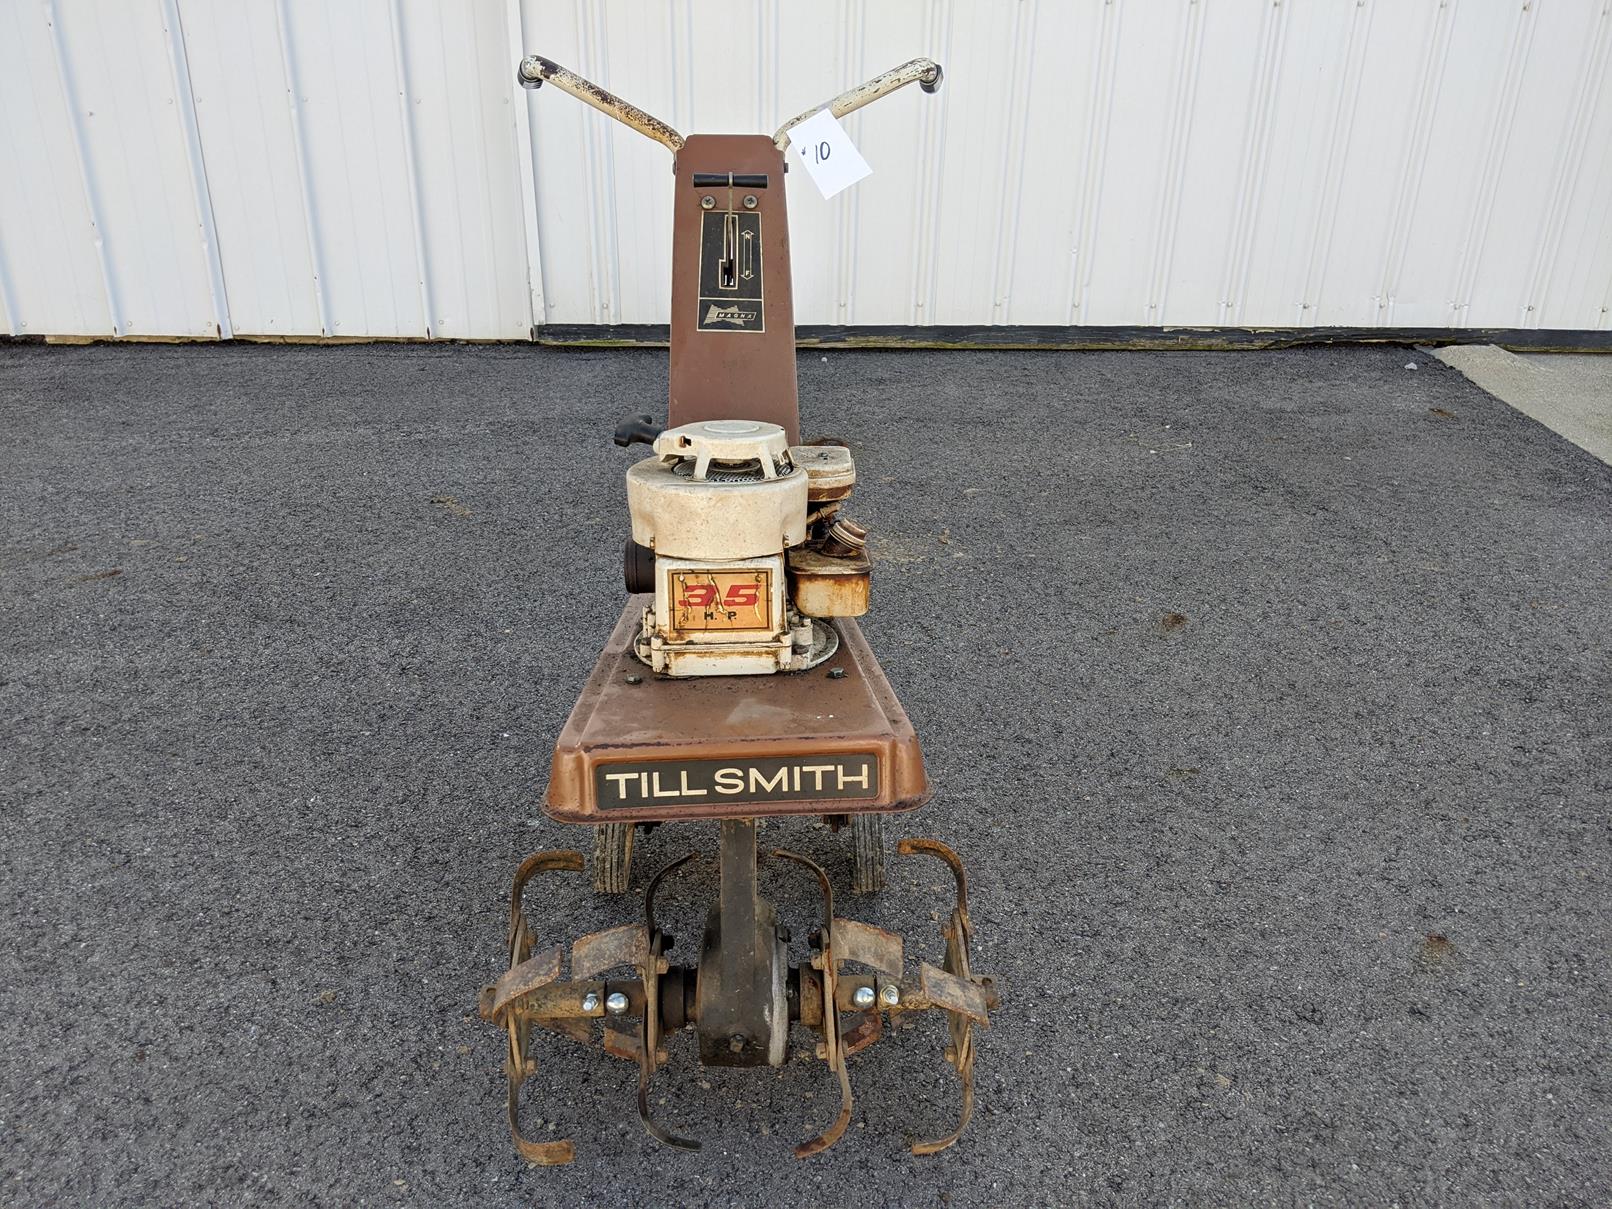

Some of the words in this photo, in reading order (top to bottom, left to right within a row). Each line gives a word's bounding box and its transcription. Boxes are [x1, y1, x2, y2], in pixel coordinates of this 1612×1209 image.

[815, 141, 831, 165] 10
[605, 770, 708, 799] TILL
[714, 763, 869, 795] SMITH
